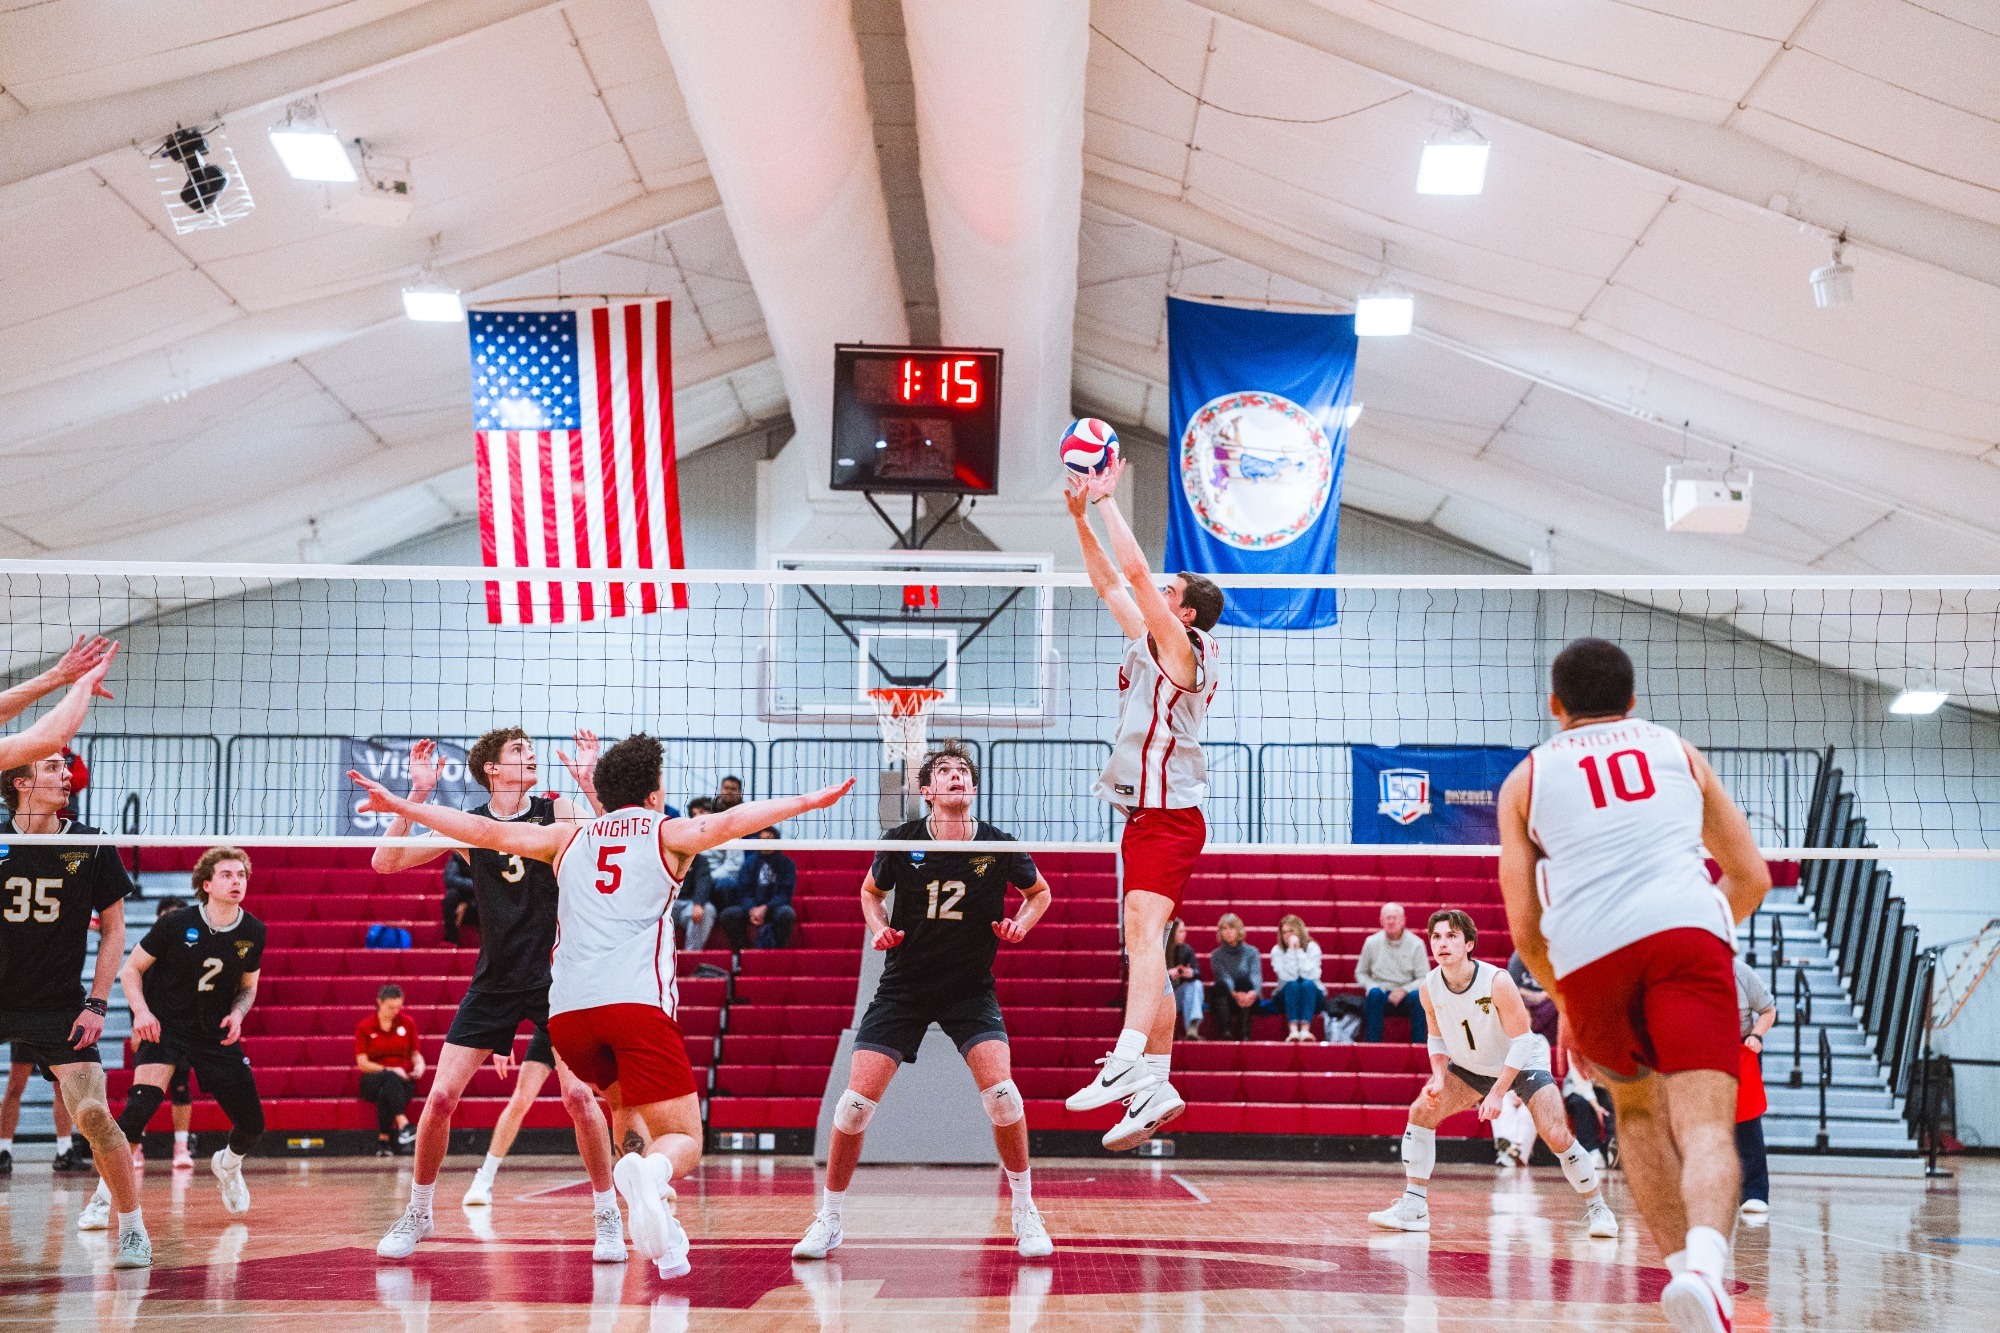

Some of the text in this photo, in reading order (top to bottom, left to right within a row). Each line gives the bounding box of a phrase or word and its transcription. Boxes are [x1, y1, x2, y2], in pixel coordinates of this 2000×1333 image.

[903, 360, 977, 403] 1:15
[1551, 725, 1661, 750] KNIGHTS
[1578, 749, 1656, 808] 10
[498, 850, 526, 883] 3
[595, 845, 627, 895] 5
[3, 876, 64, 923] 35
[926, 879, 967, 921] 12
[197, 957, 224, 992] 2
[1461, 1019, 1477, 1051] 1
